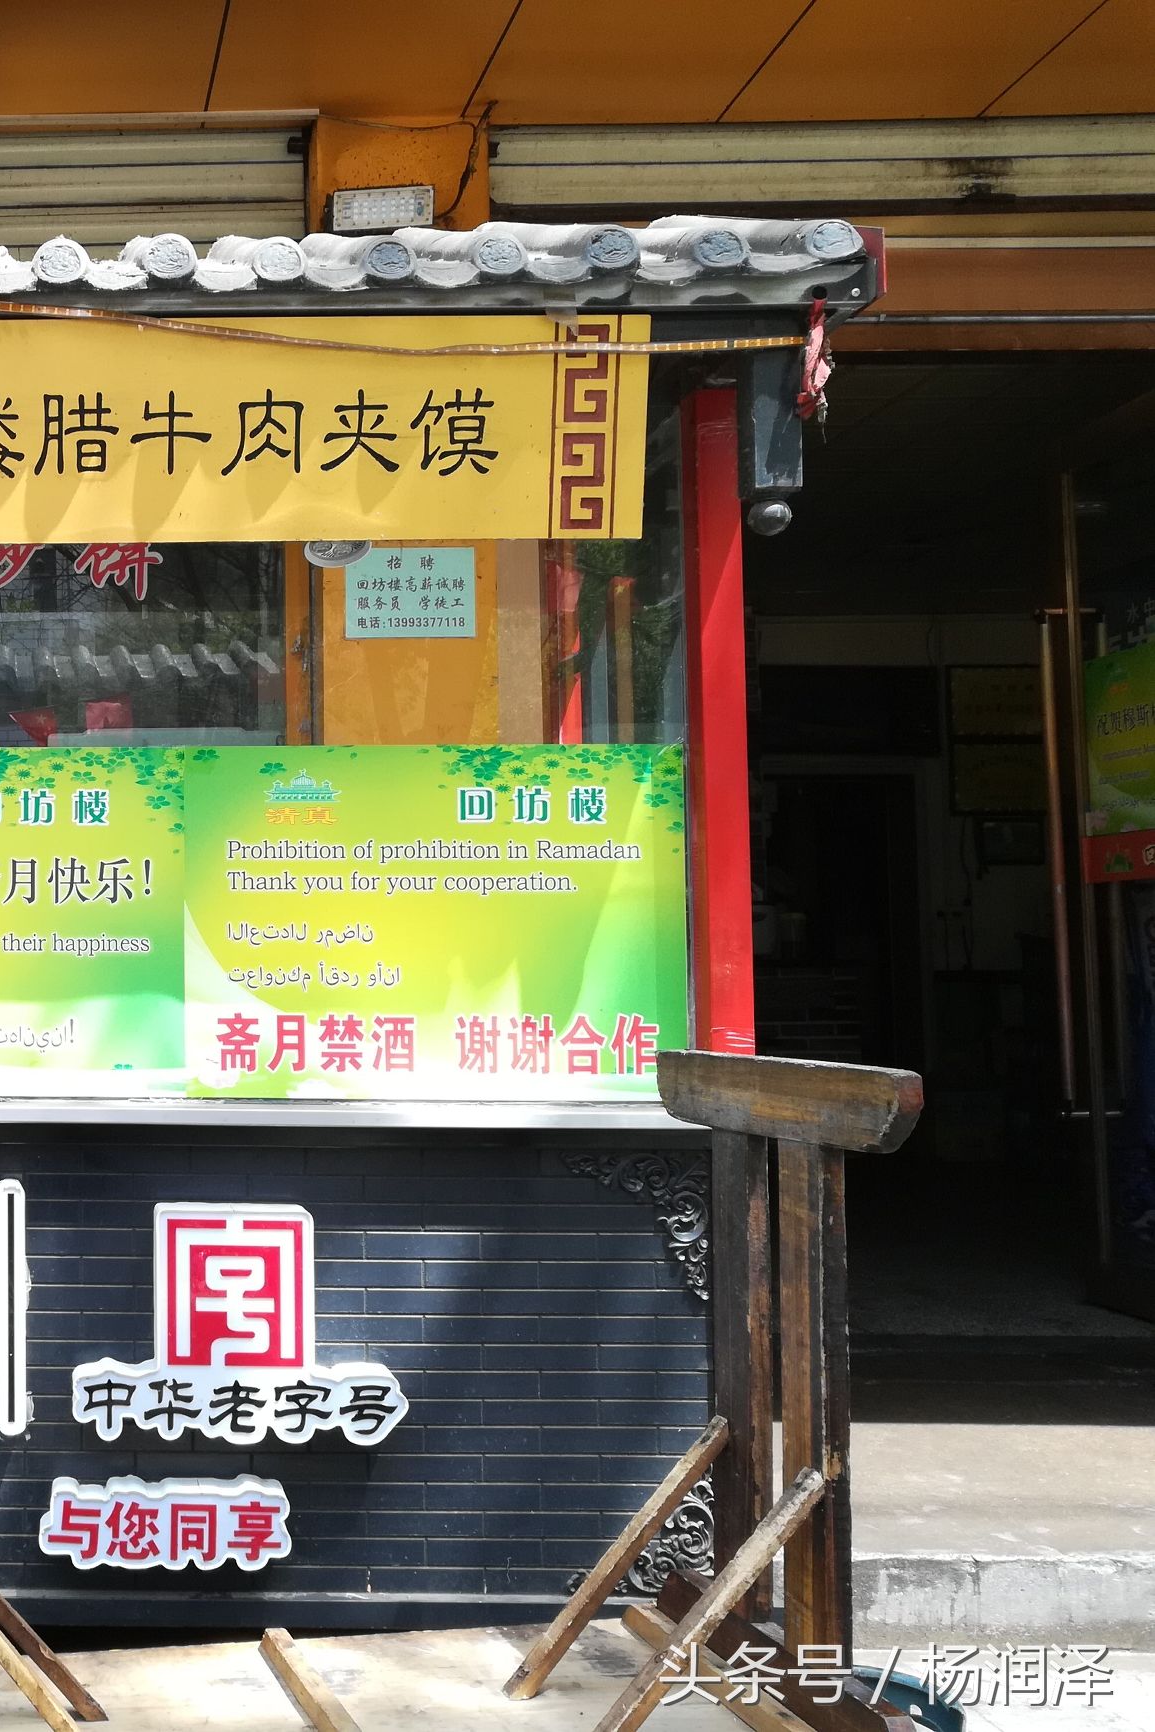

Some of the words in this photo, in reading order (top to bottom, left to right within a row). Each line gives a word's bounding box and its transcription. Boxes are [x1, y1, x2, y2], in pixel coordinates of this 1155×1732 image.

[387, 555, 436, 571] 招聘
[357, 577, 466, 592] 回坊楼高薪诚聘
[357, 595, 402, 611] 服务员
[418, 595, 465, 611] 学徒工
[265, 807, 338, 826] 清真
[457, 786, 607, 825] 回坊楼
[227, 840, 345, 860] Prohibition
[354, 840, 374, 860] of
[379, 840, 502, 863] prohibition
[508, 840, 529, 860] in
[536, 840, 641, 860] Ramadan
[228, 872, 297, 891] Thank
[303, 877, 344, 895] you
[351, 872, 380, 891] for
[386, 877, 437, 895] your
[444, 874, 578, 895] cooperation.
[3, 933, 47, 953] their
[52, 933, 150, 957] happiness
[216, 1013, 416, 1074] 斋月禁酒
[455, 1014, 658, 1076] 谢谢合作
[83, 1378, 399, 1436] 中华老字号
[48, 1499, 282, 1562] 与您同享
